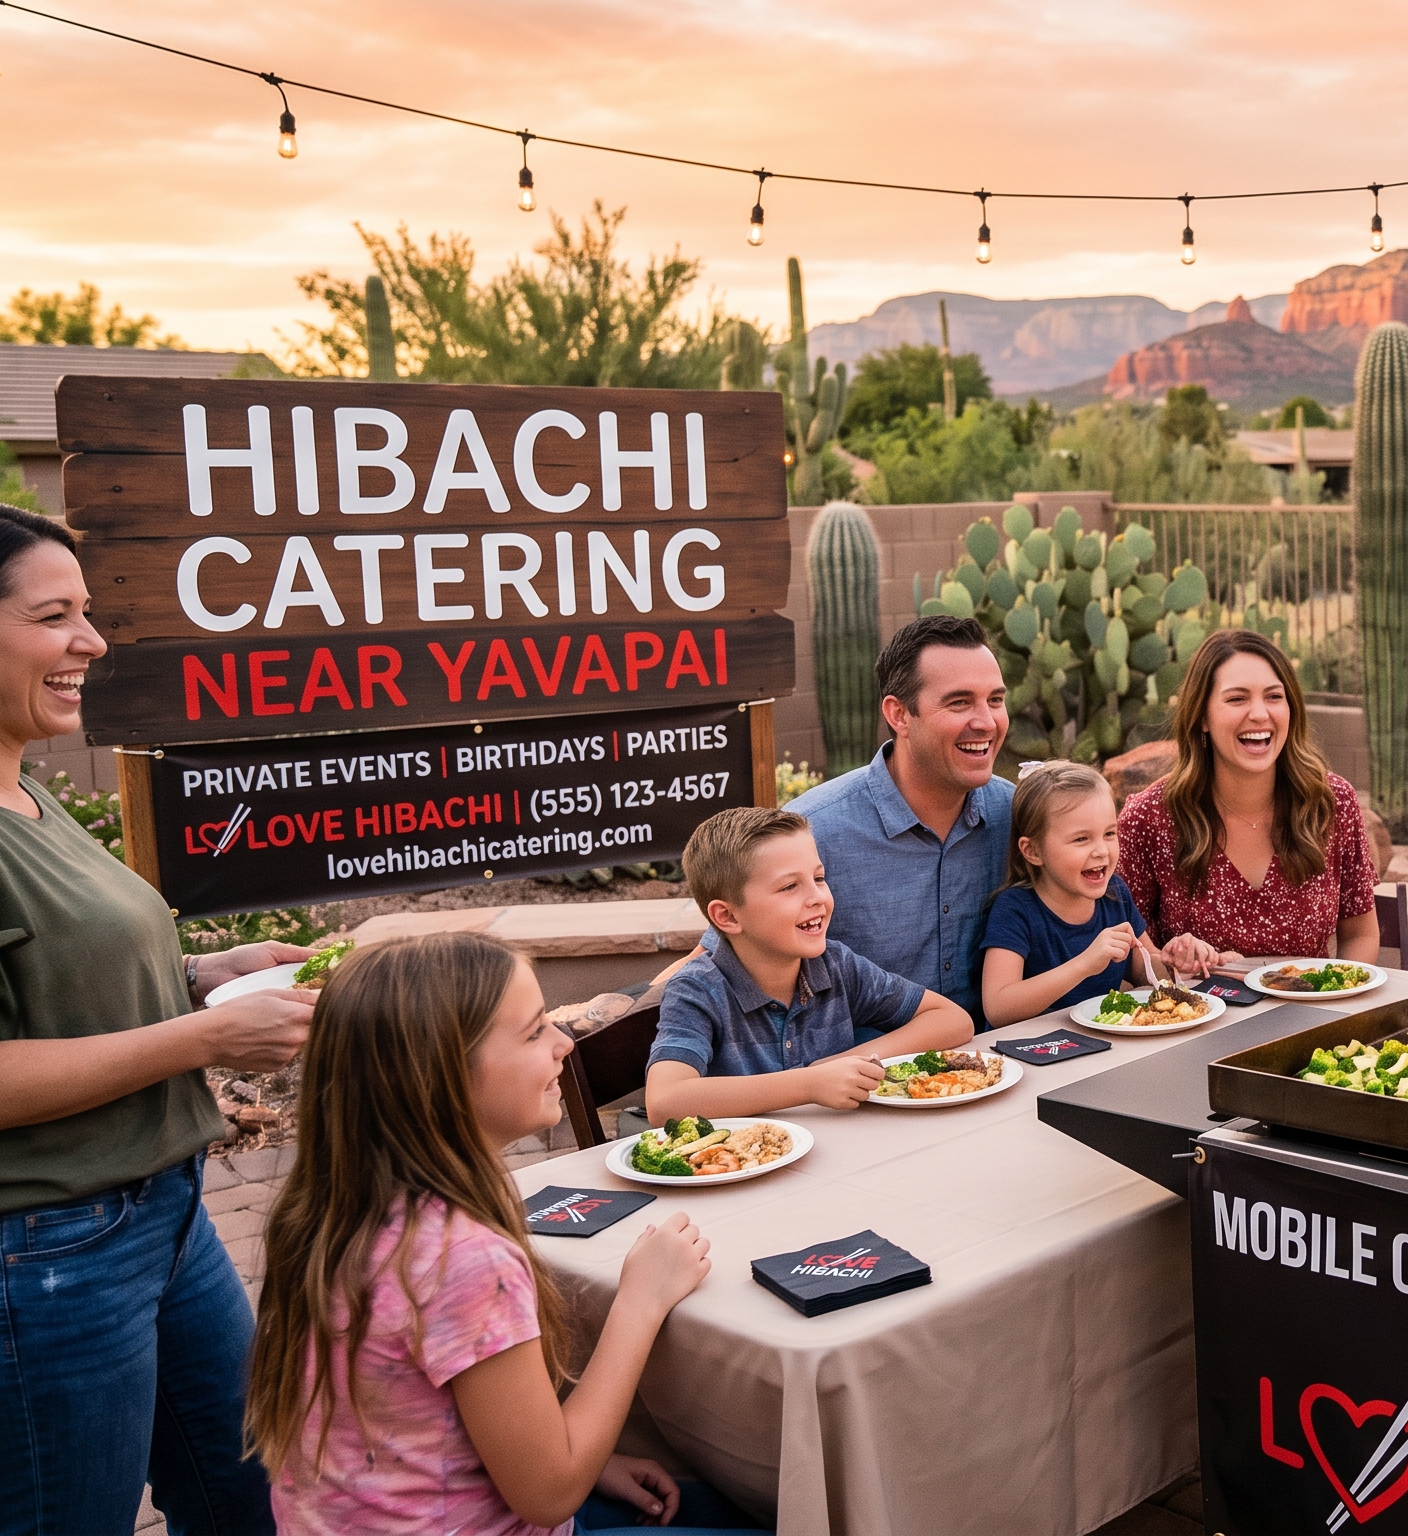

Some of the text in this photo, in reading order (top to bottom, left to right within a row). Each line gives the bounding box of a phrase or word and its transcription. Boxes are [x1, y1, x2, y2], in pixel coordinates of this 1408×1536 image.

[182, 403, 708, 517] HIBACHI
[176, 527, 726, 633] CATERING
[182, 627, 729, 721] NEAR YAVAPAI
[183, 724, 728, 797] PRIVATE EVENTS BIRTHDAYS PARTIES
[246, 809, 345, 850] LOVE
[355, 793, 503, 838] HIBACHI
[530, 783, 602, 823] (555)
[609, 771, 730, 809] 123-4567
[327, 823, 653, 880] lovehibachicatering.com
[790, 1264, 874, 1279] HIBACHI
[1212, 1190, 1377, 1286] MOBILE
